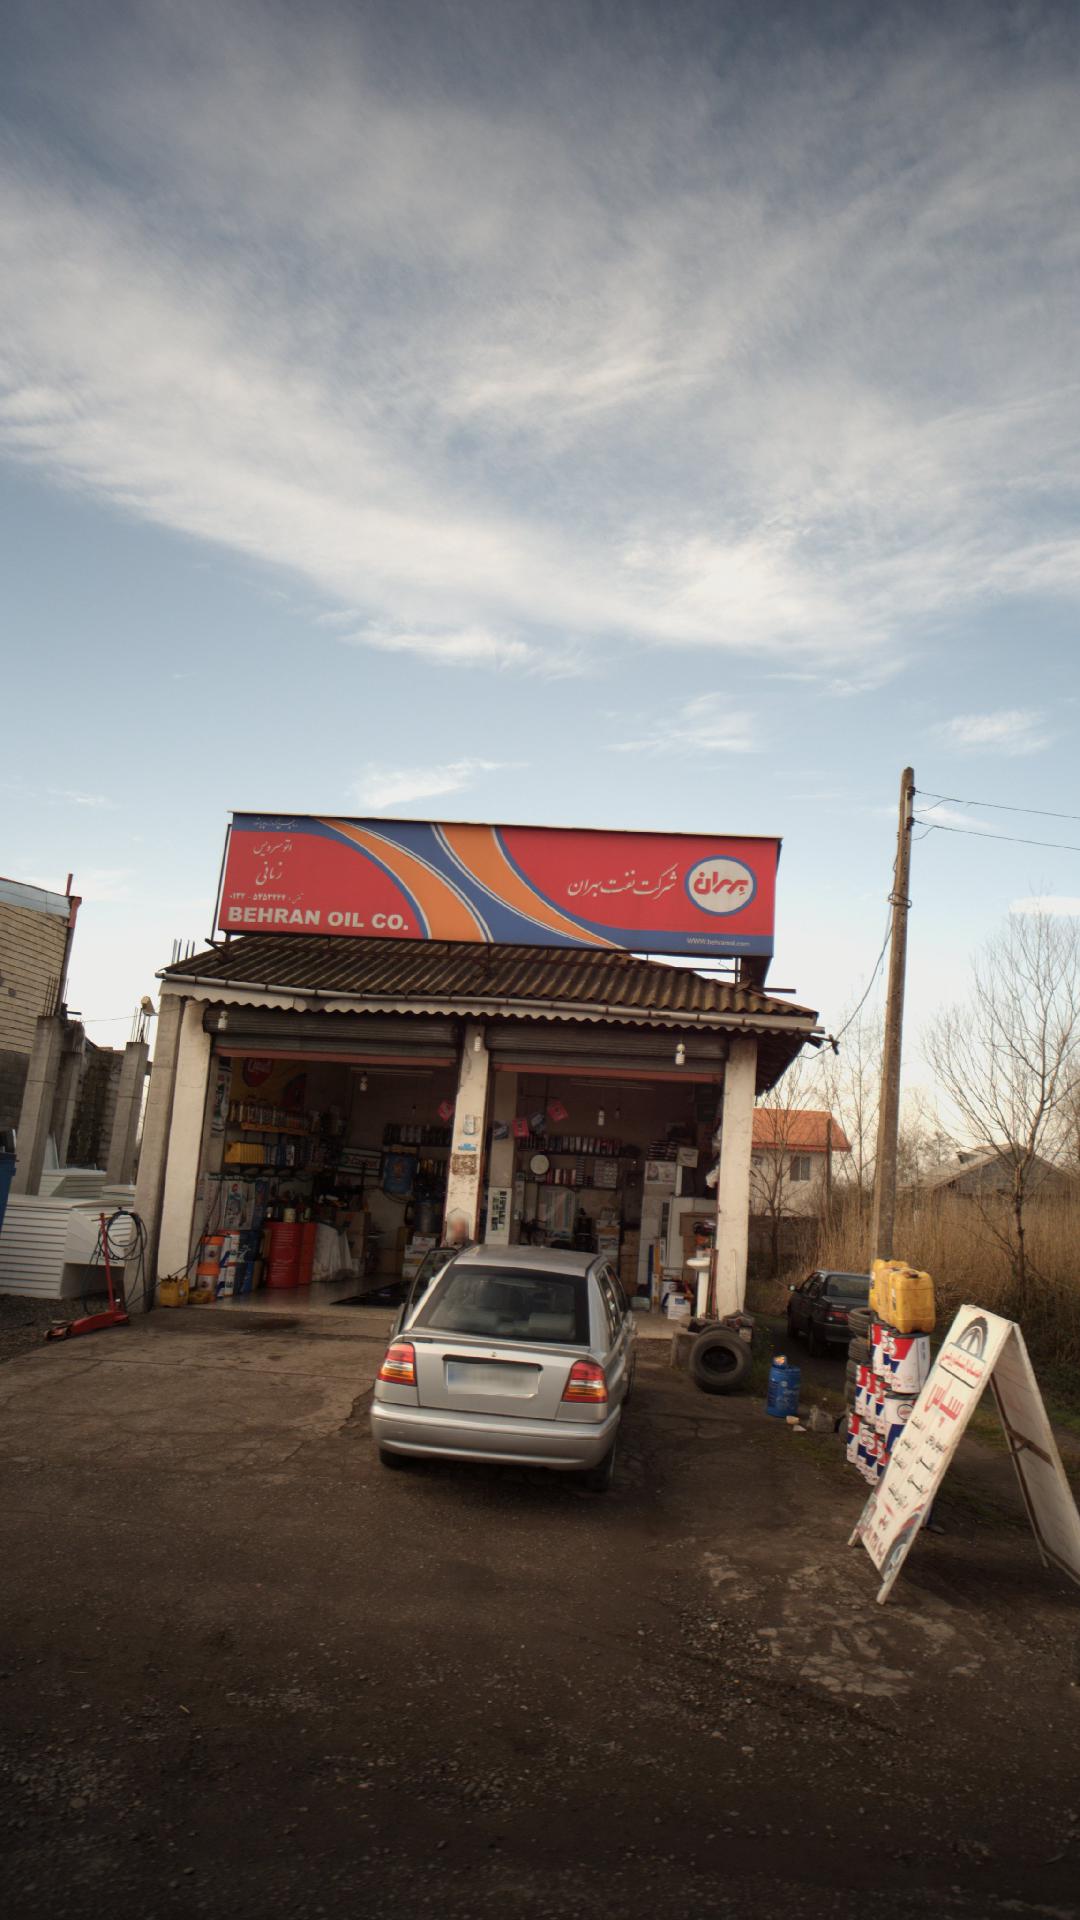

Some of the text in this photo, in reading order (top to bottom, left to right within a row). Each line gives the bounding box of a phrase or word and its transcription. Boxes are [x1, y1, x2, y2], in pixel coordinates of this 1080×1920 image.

[568, 863, 679, 900] شرکت نفت بهران
[228, 907, 409, 930] BEHRAN OIL CO.
